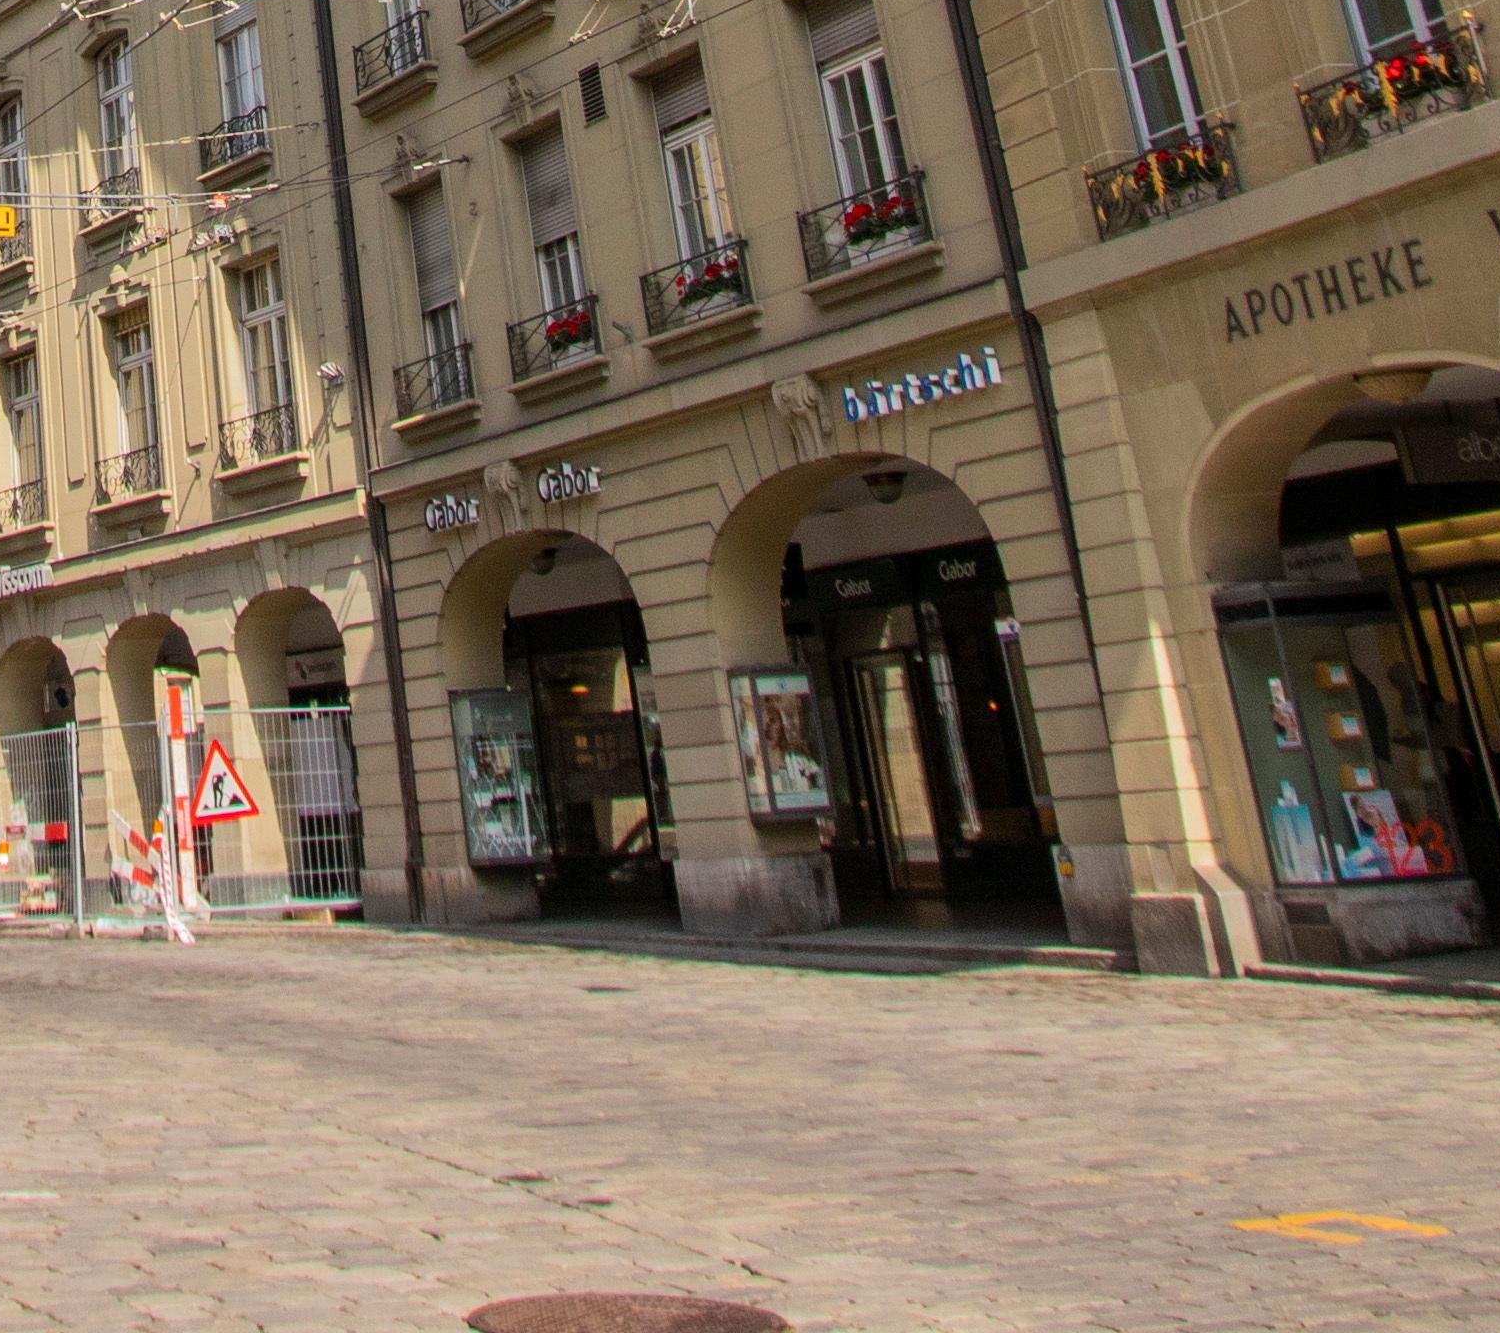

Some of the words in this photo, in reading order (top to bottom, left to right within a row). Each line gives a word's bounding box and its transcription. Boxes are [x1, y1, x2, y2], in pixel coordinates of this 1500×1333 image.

[1225, 238, 1434, 345] APOTHEKE
[842, 345, 1003, 423] bärtschi
[536, 461, 603, 504] Gabor
[424, 494, 481, 533] Gabor
[834, 576, 873, 599] Gabor
[937, 557, 978, 582] Gabor
